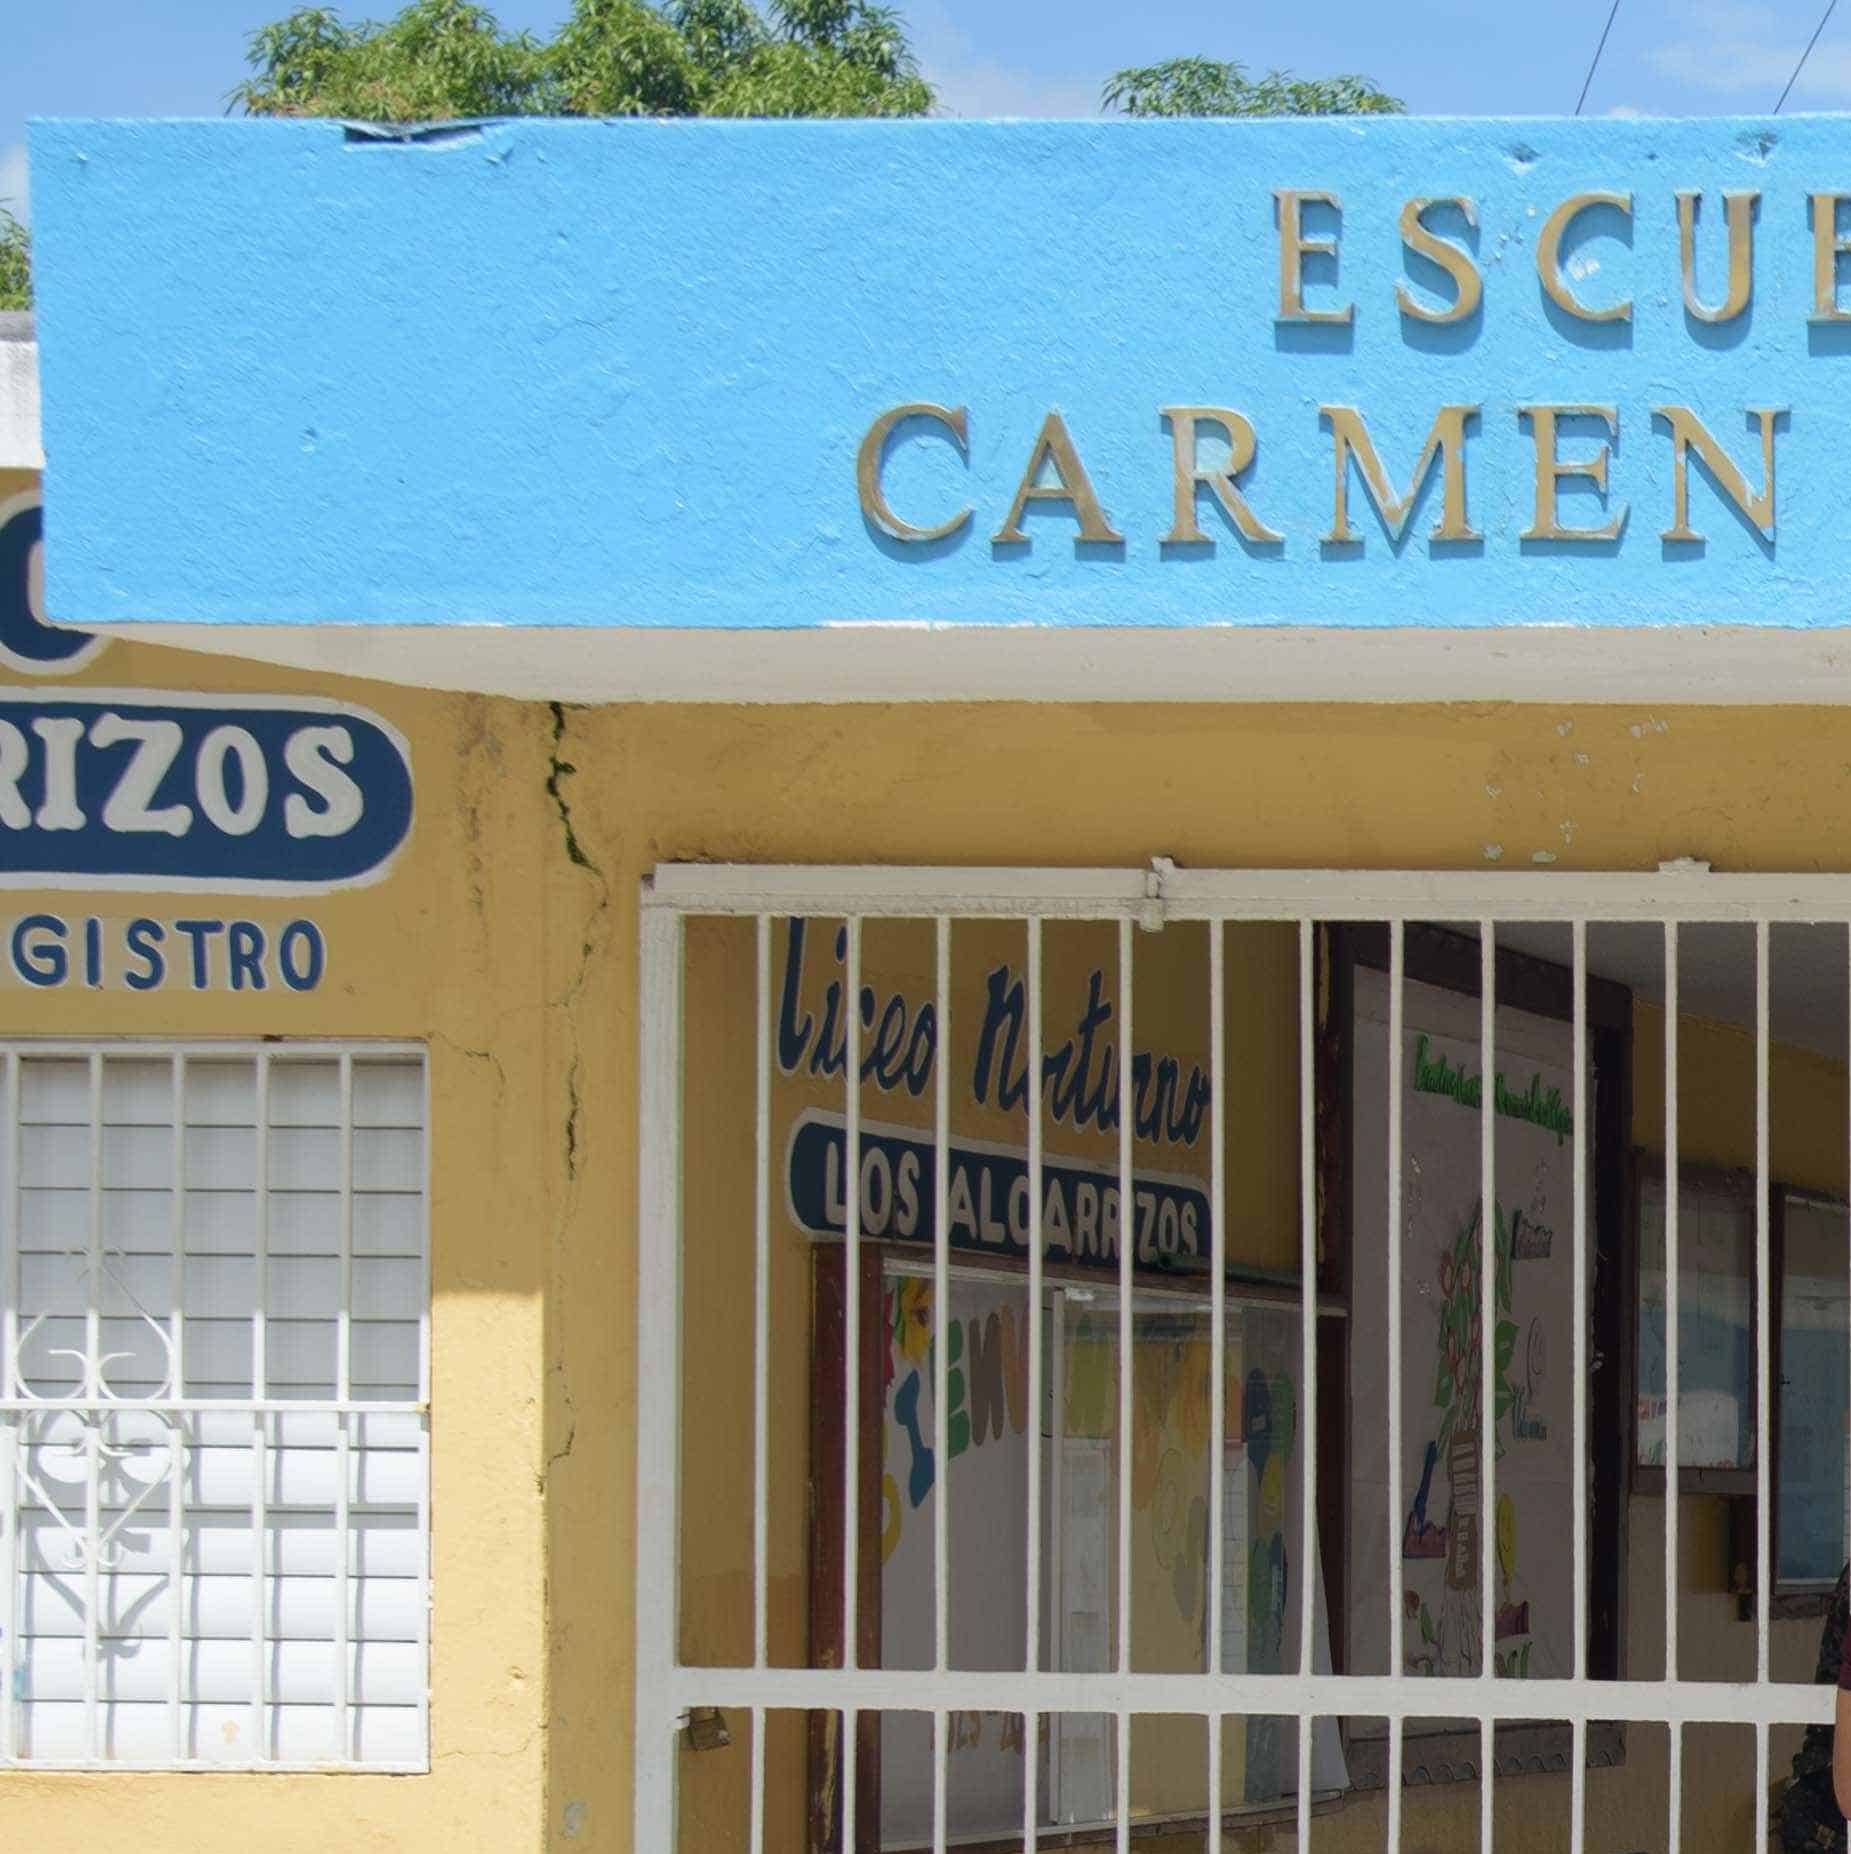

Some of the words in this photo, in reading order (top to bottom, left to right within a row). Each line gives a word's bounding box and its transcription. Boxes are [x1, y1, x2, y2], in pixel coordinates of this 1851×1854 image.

[855, 402, 1792, 550] CARMEN
[11, 914, 328, 992] GISTRO
[824, 1140, 920, 1238] LOS
[947, 1163, 1200, 1265] ALCARRZOS
